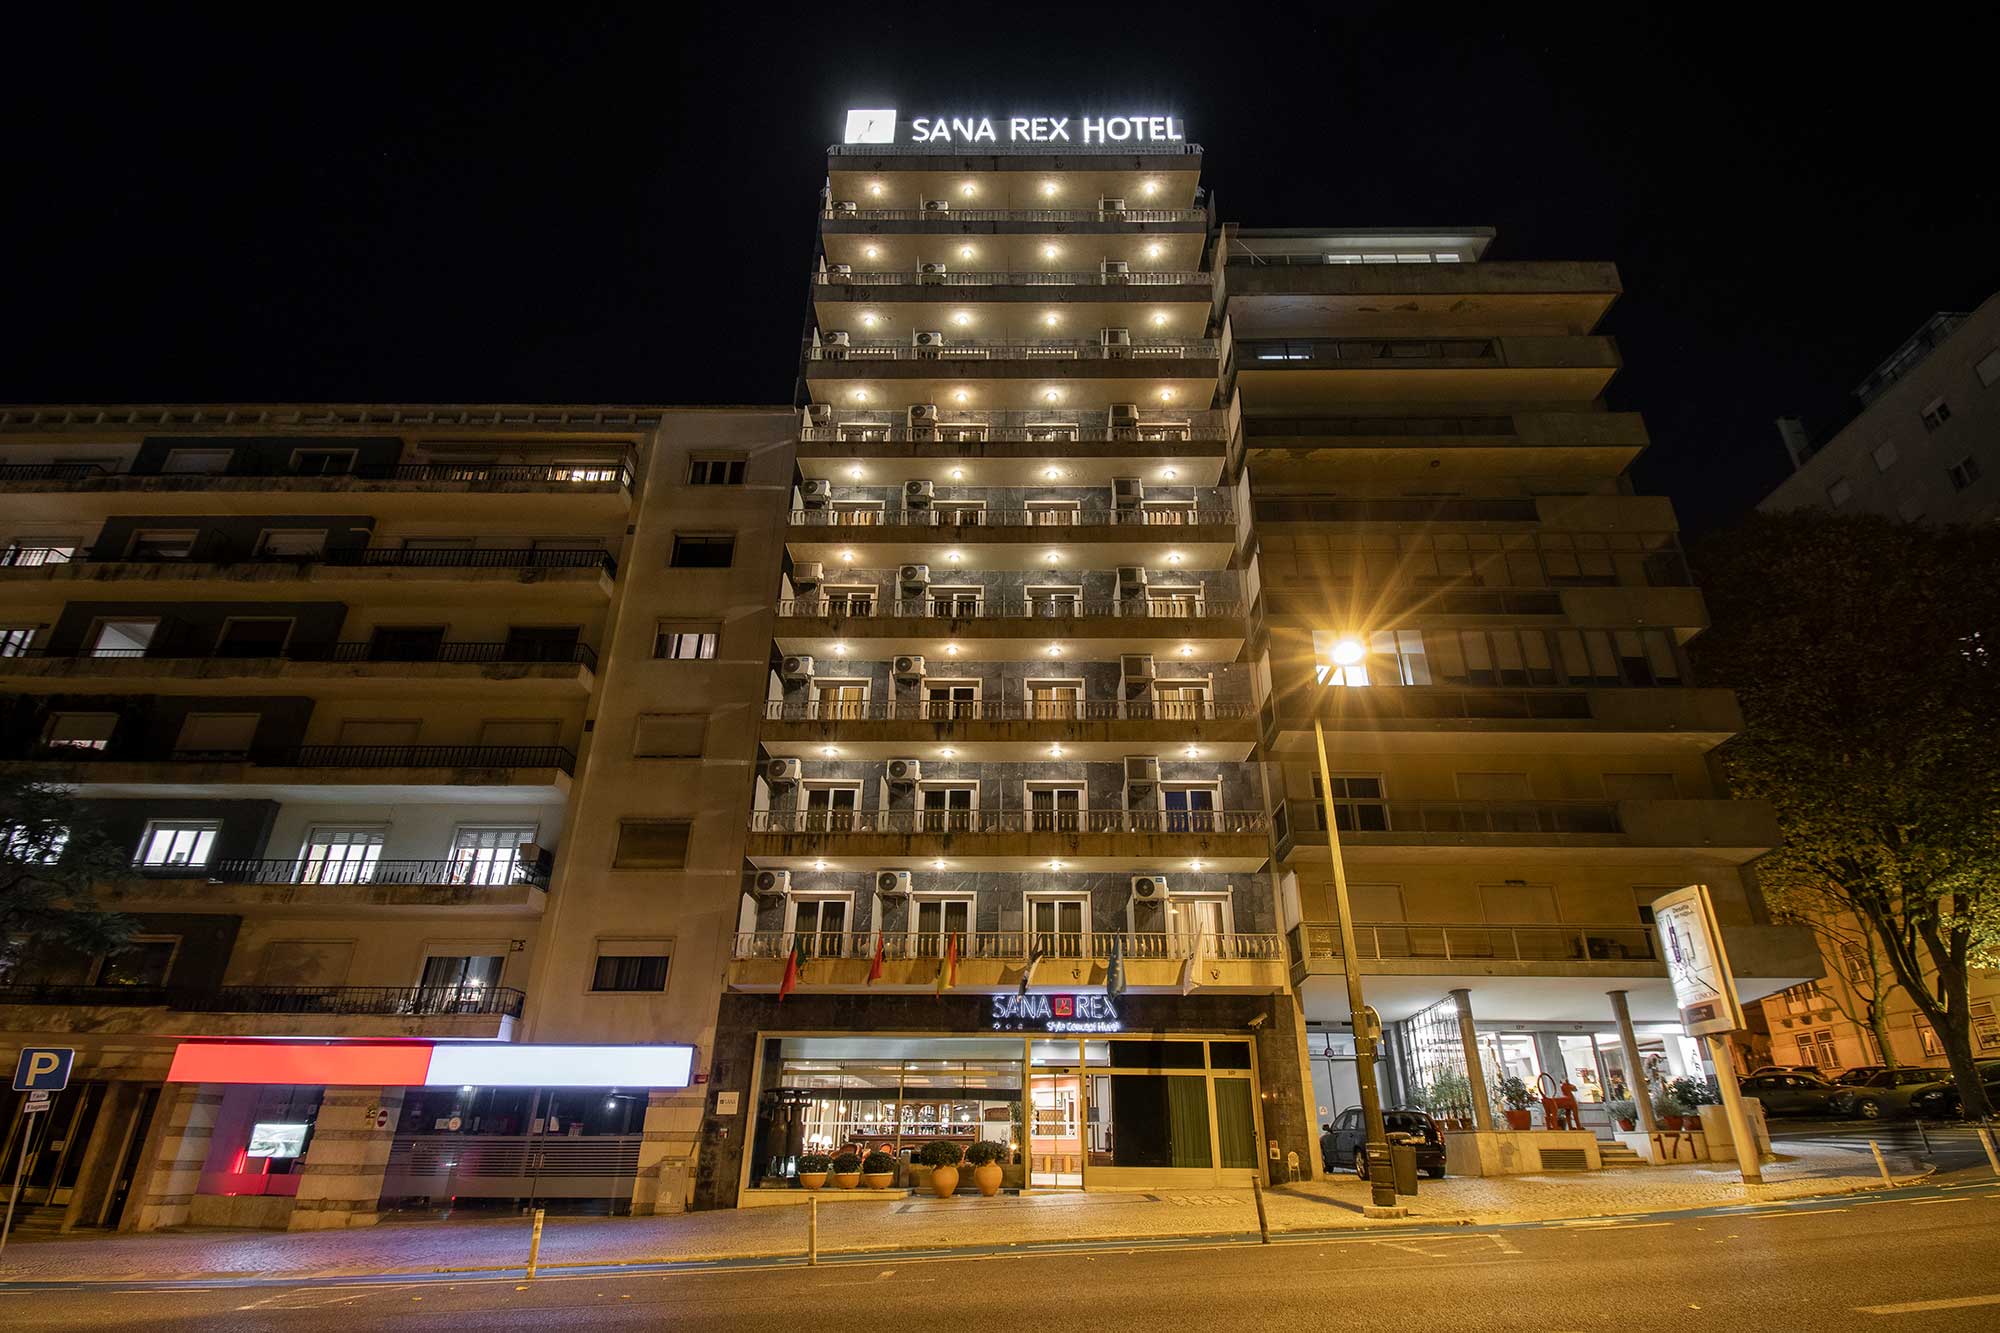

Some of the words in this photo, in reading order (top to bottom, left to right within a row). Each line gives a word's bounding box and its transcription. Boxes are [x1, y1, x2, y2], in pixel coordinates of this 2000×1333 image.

[912, 118, 996, 142] SANA
[1010, 117, 1070, 142] REX
[1083, 117, 1182, 143] HOTEL
[992, 995, 1051, 1019] SANA
[1076, 995, 1118, 1019] REX
[25, 1052, 60, 1087] P
[1653, 1132, 1698, 1160] 171
